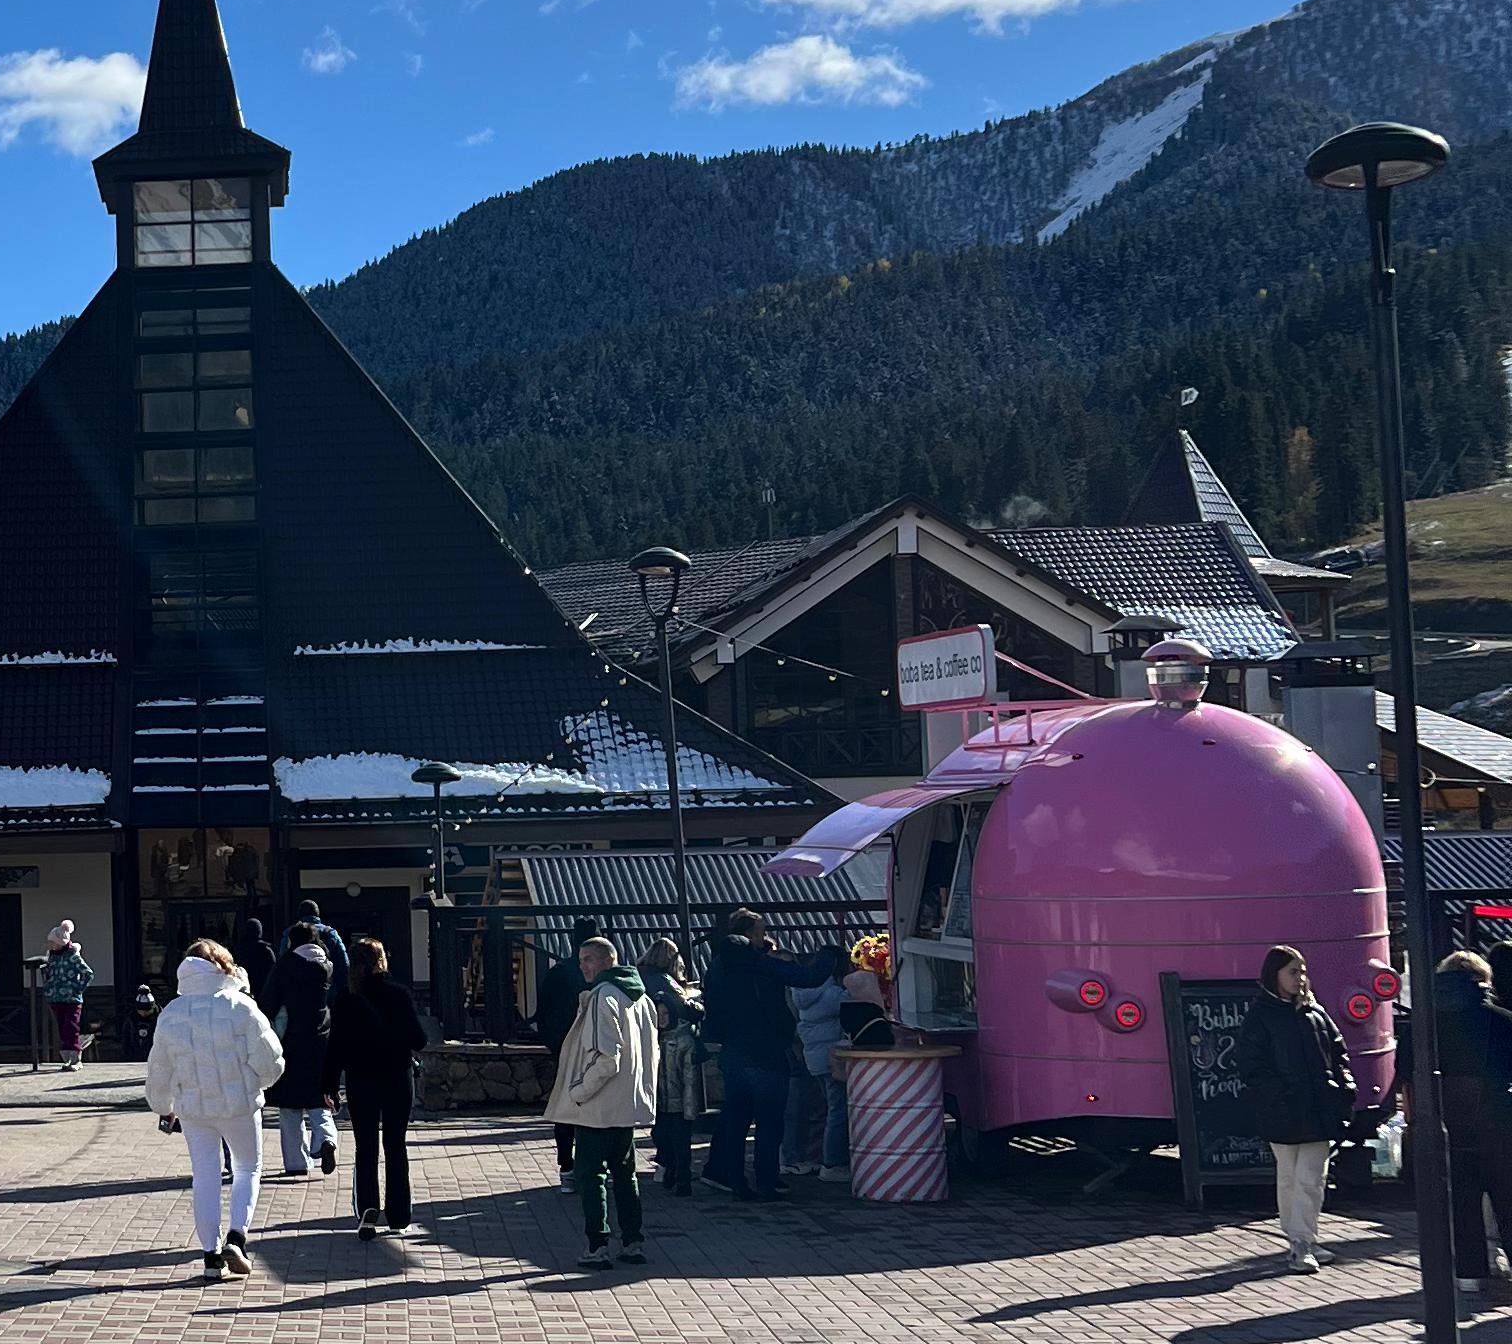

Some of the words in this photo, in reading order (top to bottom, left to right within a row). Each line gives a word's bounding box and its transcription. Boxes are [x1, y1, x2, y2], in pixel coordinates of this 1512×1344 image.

[899, 661, 919, 684] boba
[920, 660, 935, 681] tea
[936, 656, 943, 679] &
[943, 653, 969, 678] coffee
[970, 655, 982, 674] co
